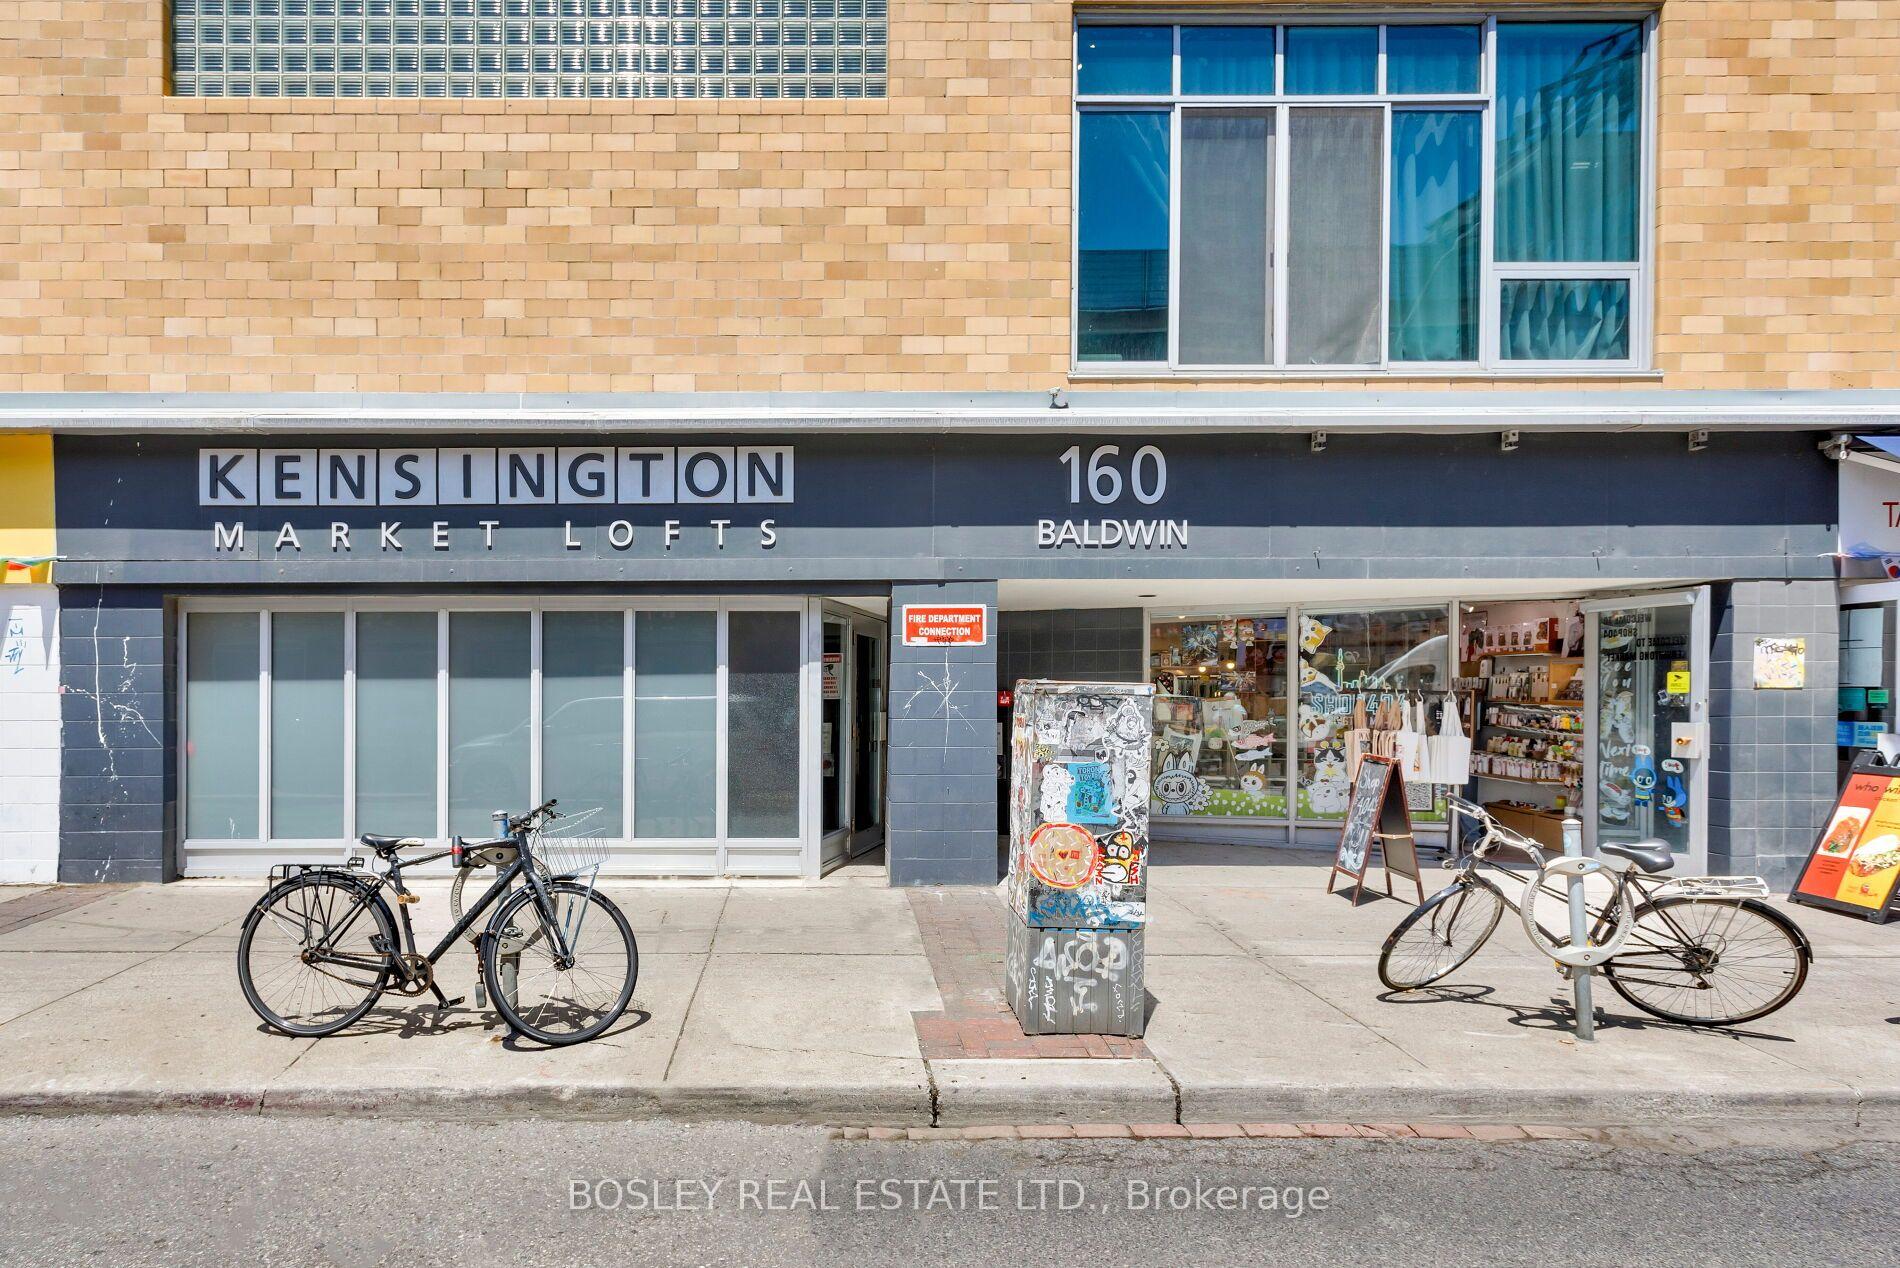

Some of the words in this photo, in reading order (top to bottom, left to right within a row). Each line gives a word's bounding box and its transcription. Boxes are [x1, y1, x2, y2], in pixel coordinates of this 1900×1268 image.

[209, 451, 783, 499] KENSINGTON
[1059, 445, 1167, 505] 160
[214, 519, 500, 550] MARKET
[565, 519, 776, 550] LOFTS
[1038, 519, 1188, 548] BALDWIN
[908, 614, 927, 623] FIRE
[928, 614, 981, 623] DEPARTMENT
[918, 627, 971, 636] CONNECTION
